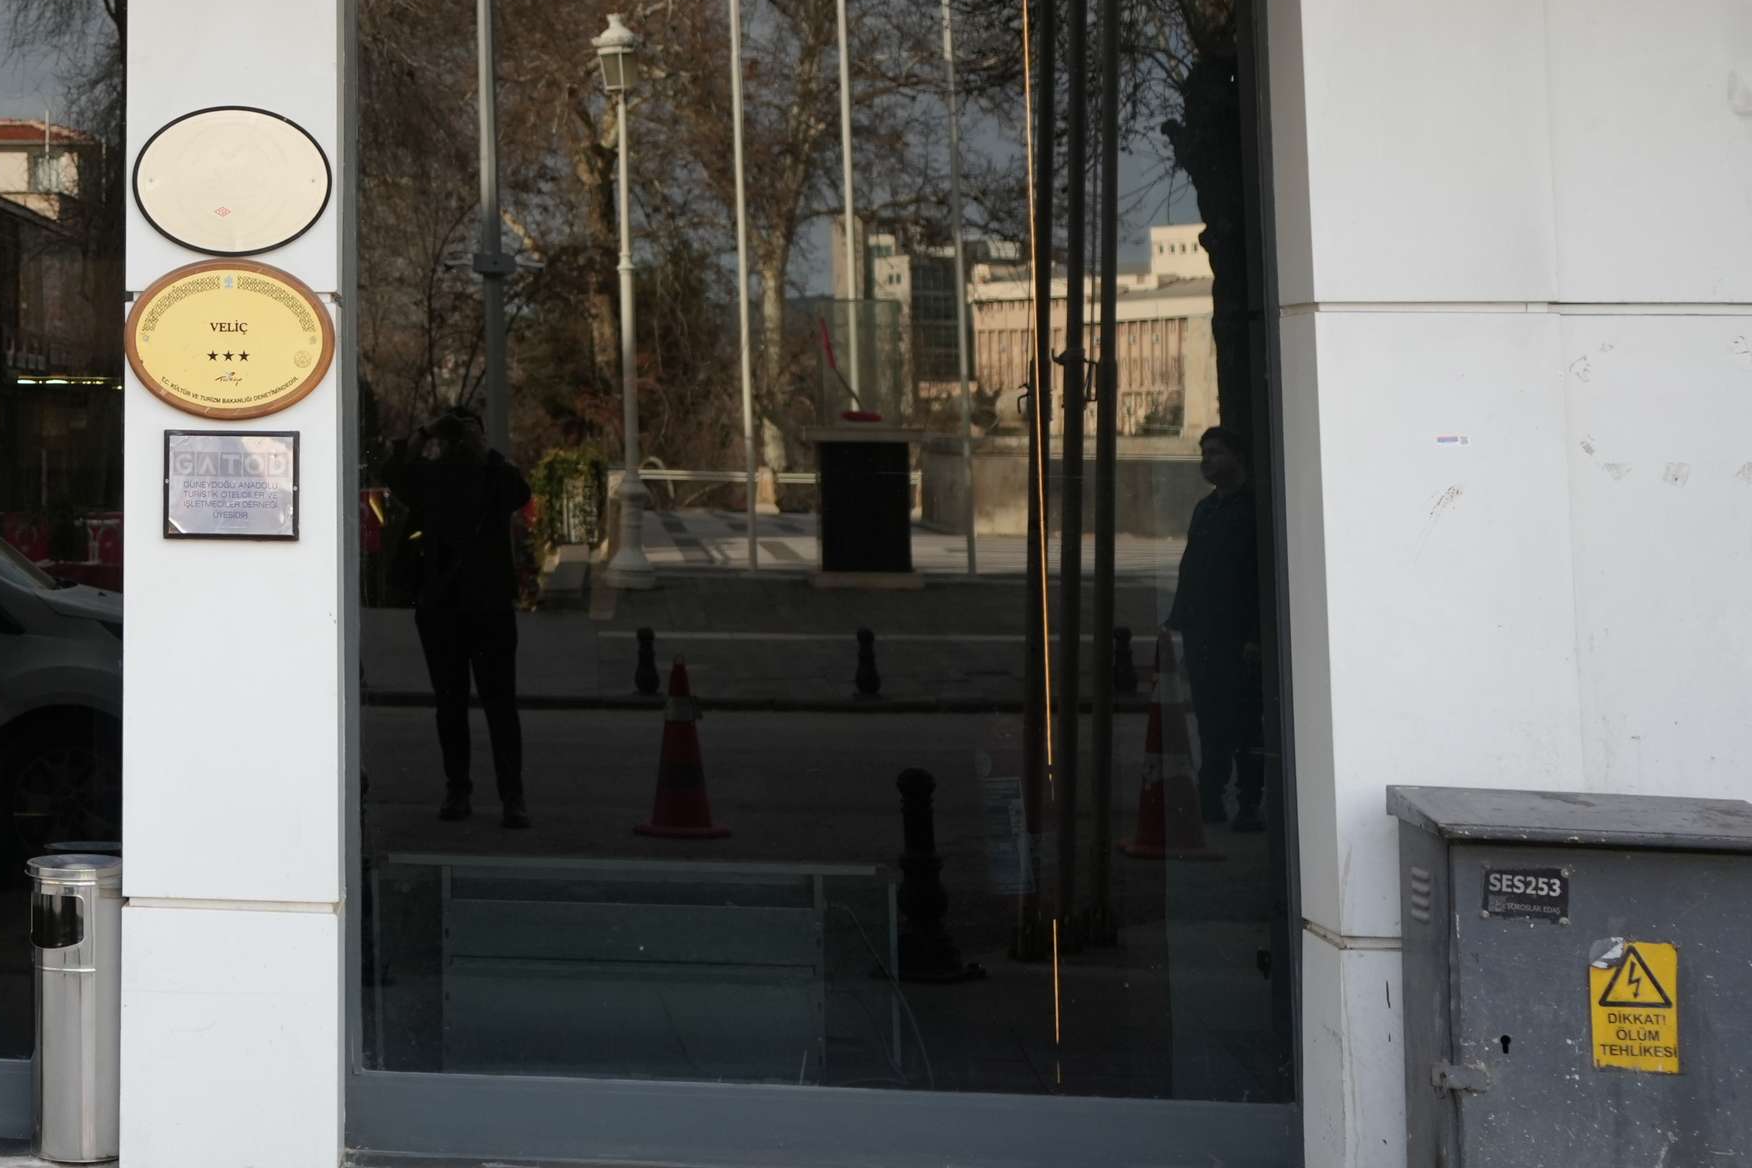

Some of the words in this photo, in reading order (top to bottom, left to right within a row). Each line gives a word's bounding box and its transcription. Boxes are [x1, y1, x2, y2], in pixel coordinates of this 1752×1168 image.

[210, 320, 248, 335] VELİÇ
[1488, 873, 1561, 897] SES253
[1616, 1026, 1661, 1042] ÖLÜM
